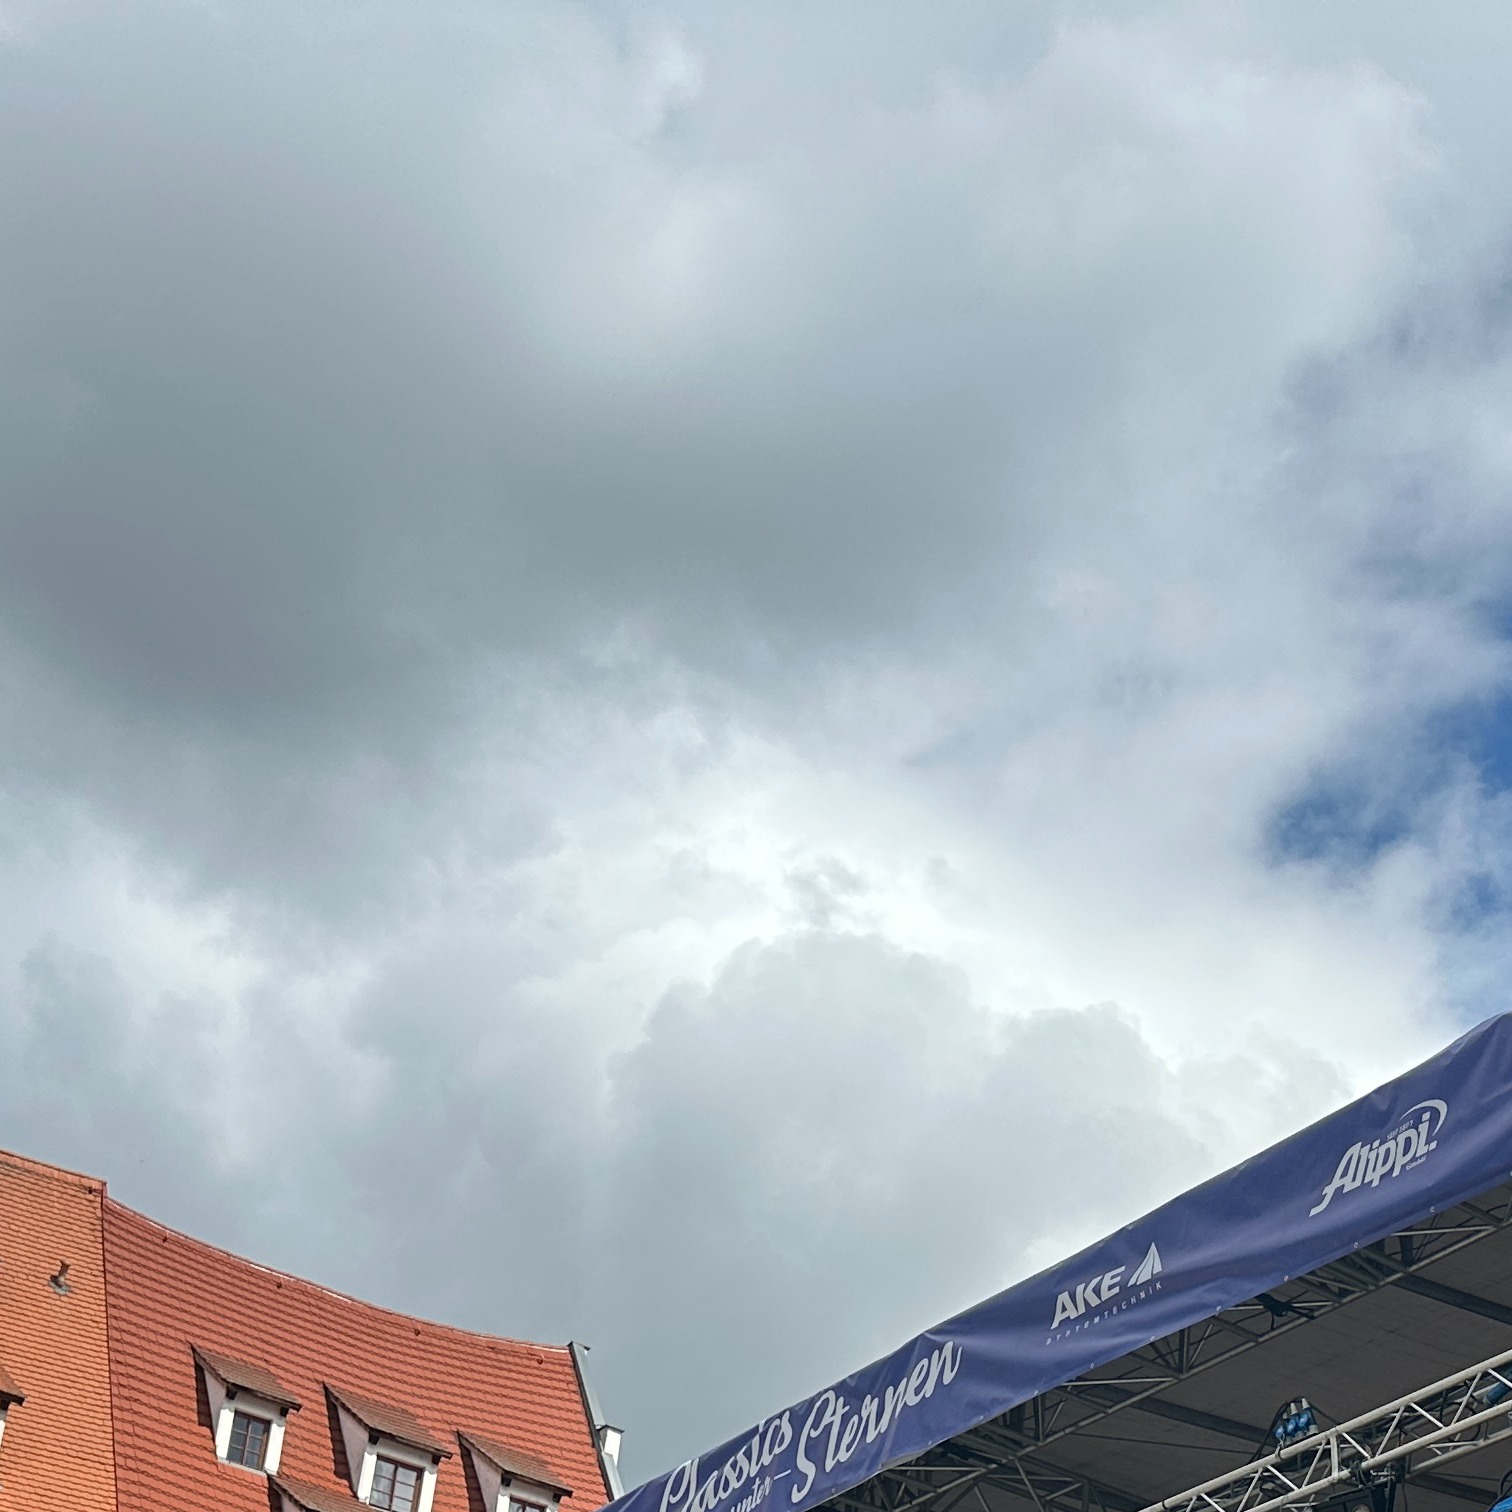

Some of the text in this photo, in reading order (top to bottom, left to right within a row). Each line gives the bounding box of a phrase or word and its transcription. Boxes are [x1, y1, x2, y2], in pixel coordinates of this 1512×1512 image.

[1045, 1281, 1163, 1346] SYSTEMTECHNIK
[1050, 1265, 1126, 1330] AKE
[791, 1340, 963, 1504] Sternen
